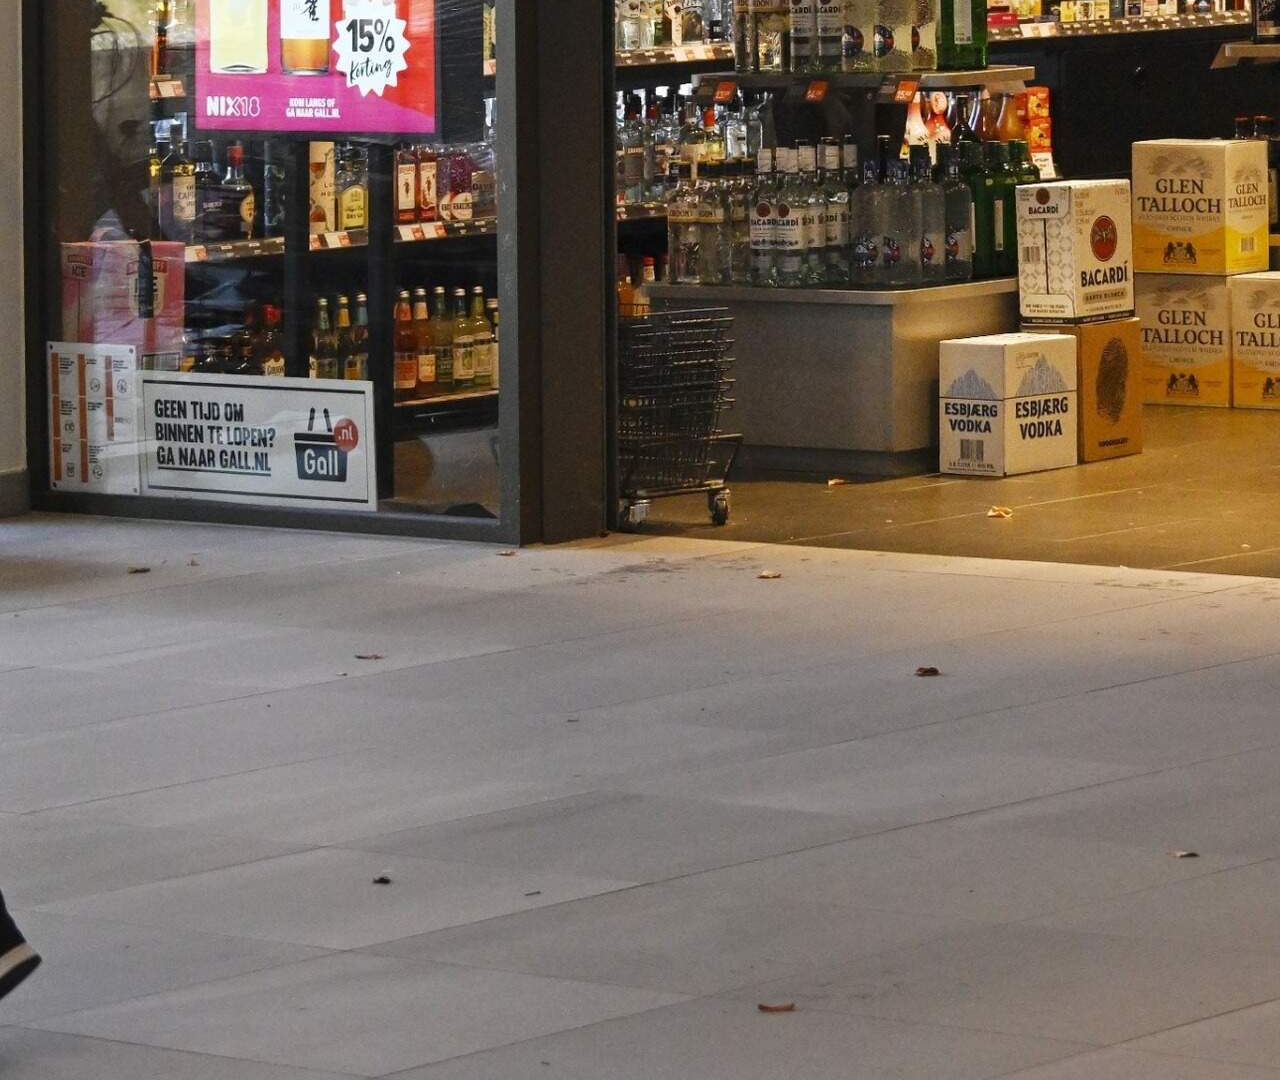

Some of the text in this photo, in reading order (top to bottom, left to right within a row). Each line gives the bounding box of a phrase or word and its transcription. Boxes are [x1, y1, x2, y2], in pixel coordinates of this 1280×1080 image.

[345, 17, 395, 54] 15%
[349, 58, 393, 83] Korting
[206, 96, 261, 117] NIX18
[1156, 178, 1204, 195] GLEN
[1236, 183, 1259, 195] GLEN
[1028, 203, 1059, 215] BACARDÍ
[1137, 196, 1221, 213] TALLOCH
[1228, 195, 1267, 209] TALLOCH
[1081, 260, 1128, 288] BACARDÍ
[1158, 309, 1206, 326] GLEN
[1141, 327, 1223, 345] TALLOCH
[154, 399, 244, 422] GEEN TIJD OM
[944, 402, 998, 417] ESBJÆRG
[1015, 397, 1068, 418] ESBJÆRG
[155, 422, 276, 448] BINNEN TE LOPEN?
[338, 427, 354, 441] .nl
[949, 418, 992, 434] VODKA
[1020, 419, 1063, 440] VODKA
[156, 446, 272, 471] GA NAAR GALL.NL
[303, 448, 339, 477] Gall
